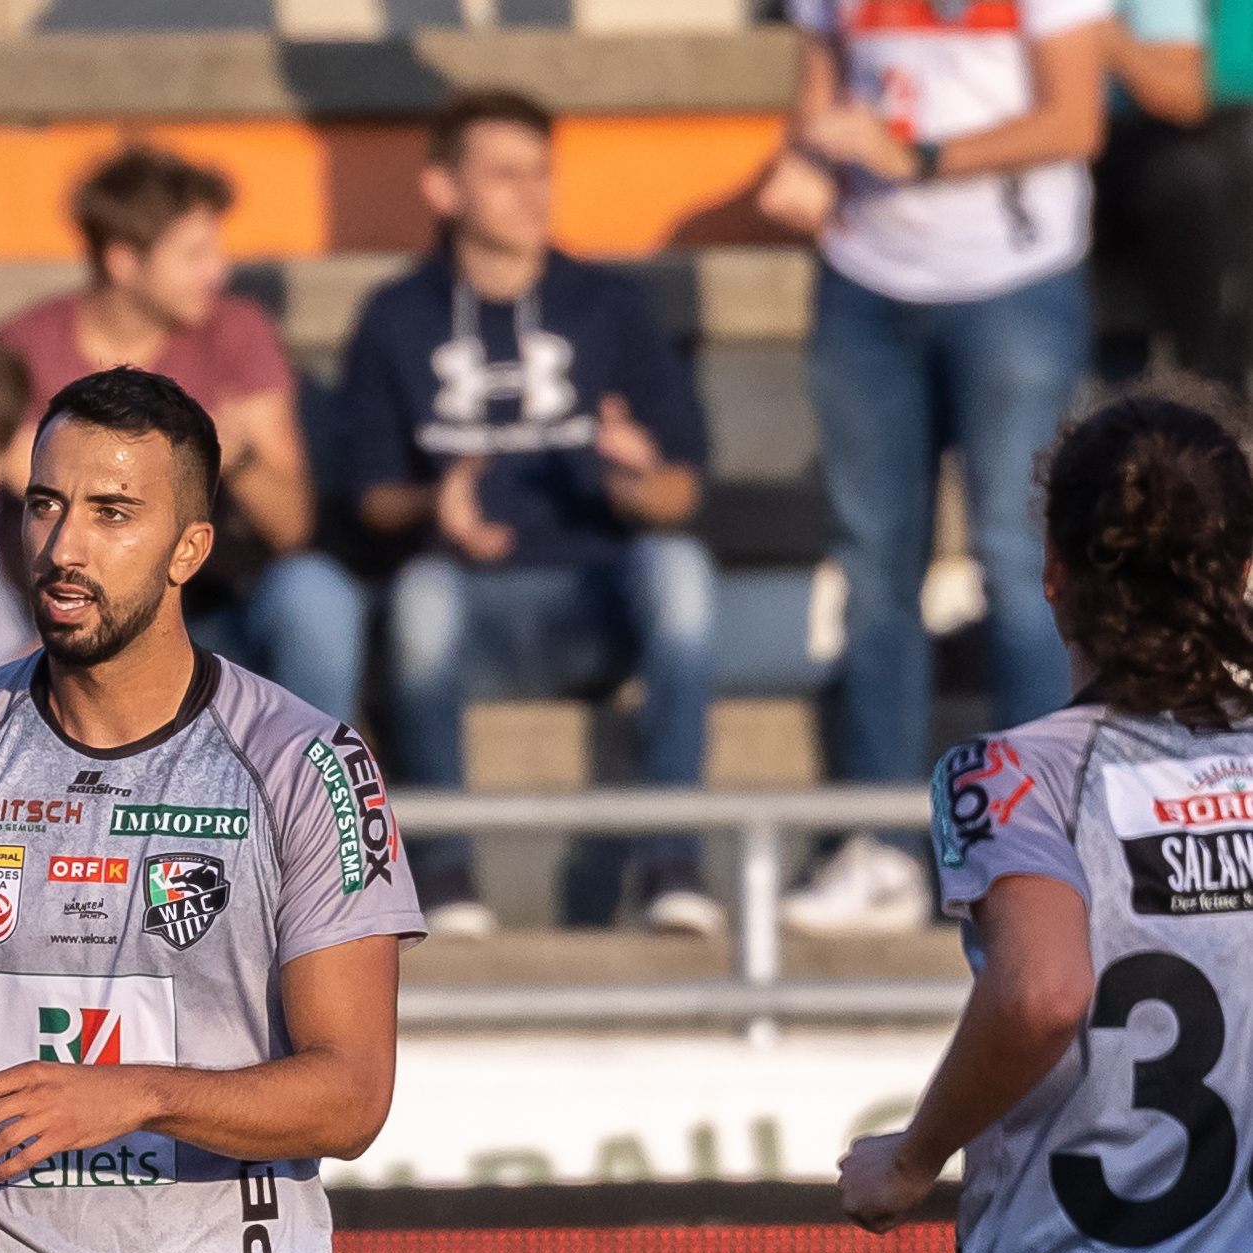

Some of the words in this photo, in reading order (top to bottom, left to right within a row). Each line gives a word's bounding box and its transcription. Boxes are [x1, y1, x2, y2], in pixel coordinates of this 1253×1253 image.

[113, 808, 248, 836] IMMOPRO
[307, 741, 360, 885] BAU-SYSTEME
[331, 721, 393, 888] VELOX
[52, 860, 99, 878] ORF
[108, 863, 124, 879] K
[158, 894, 214, 923] WAC
[50, 933, 118, 945] www.velox.at
[1049, 951, 1238, 1248] 3
[27, 1145, 160, 1187] ellets
